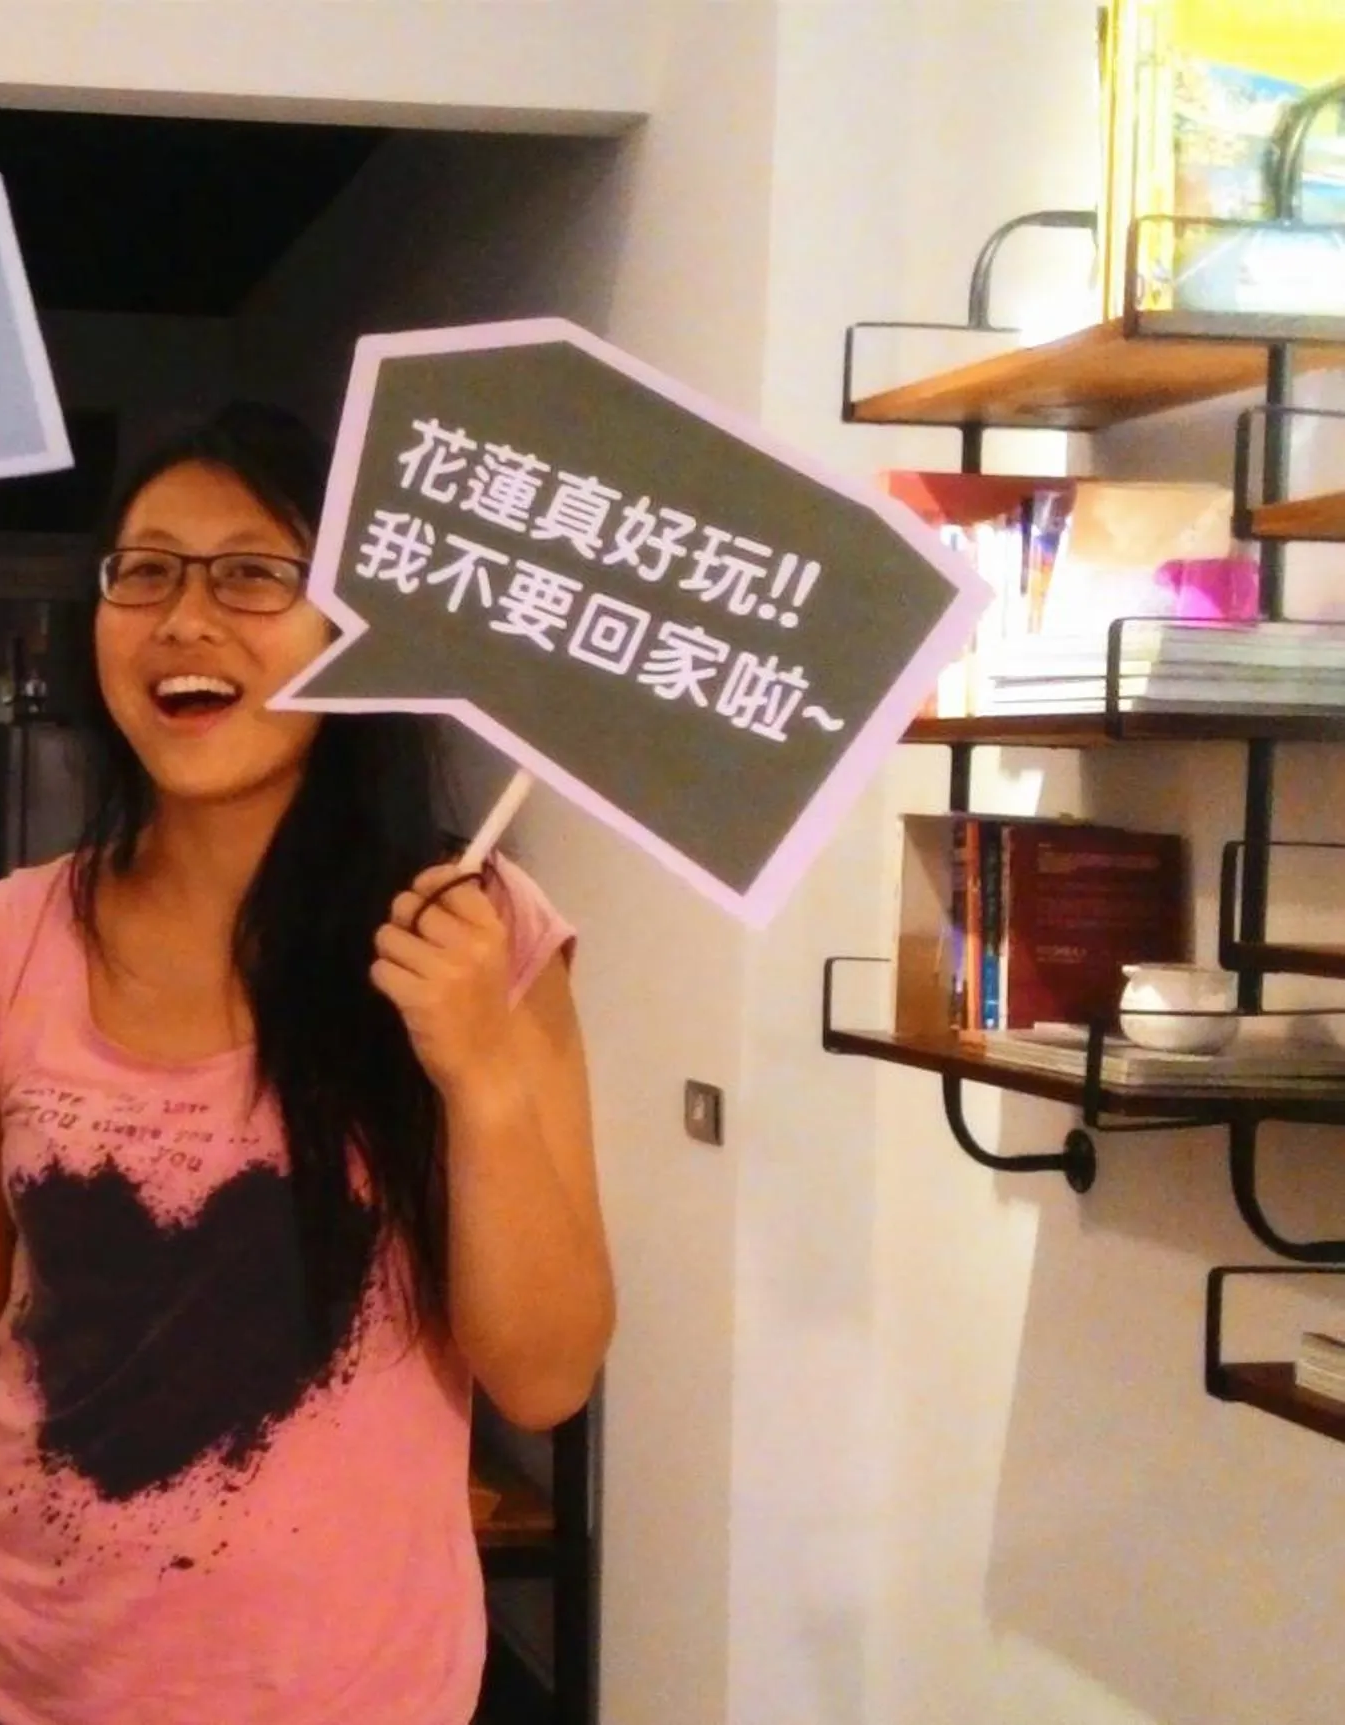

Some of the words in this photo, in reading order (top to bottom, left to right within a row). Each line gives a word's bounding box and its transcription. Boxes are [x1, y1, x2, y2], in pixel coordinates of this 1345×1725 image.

[355, 509, 846, 743] 我不要回家啦~
[397, 417, 822, 629] 花蓮真好玩!!
